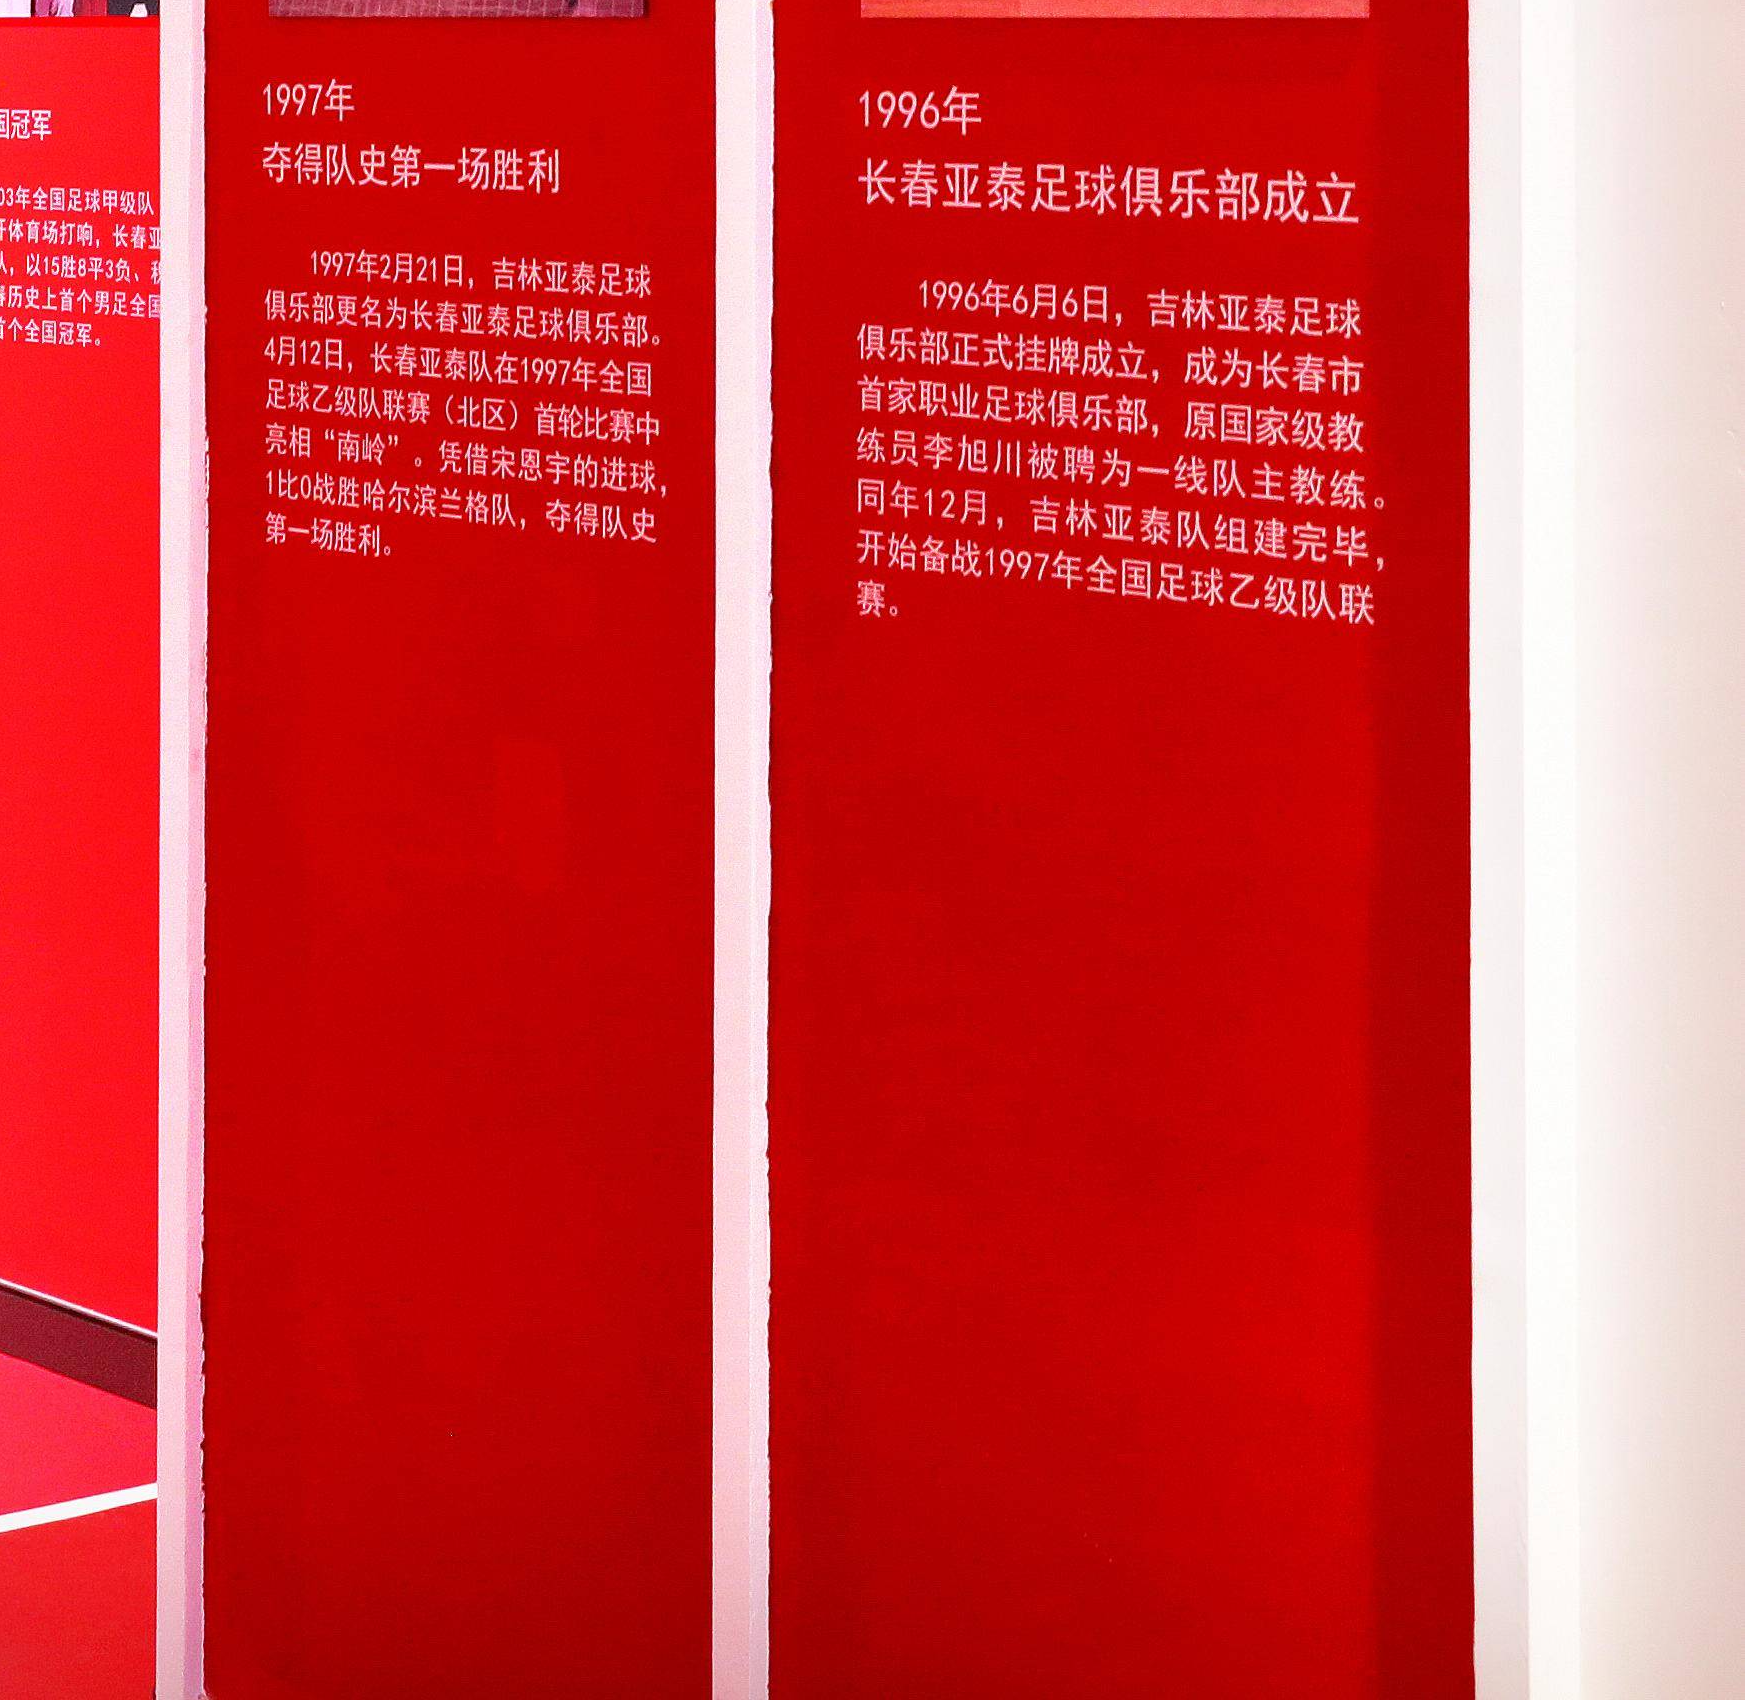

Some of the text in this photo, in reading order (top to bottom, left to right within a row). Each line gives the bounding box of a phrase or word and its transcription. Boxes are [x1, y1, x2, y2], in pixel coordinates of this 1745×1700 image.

[262, 79, 355, 122] 1997年
[858, 86, 983, 136] 1996年
[262, 142, 561, 195] 夺得队史第一场胜利
[858, 158, 1359, 224] 长春亚泰足球俱乐部成立
[310, 249, 652, 299] 1997年2月21日，吉林亚泰足球
[264, 289, 661, 348] 俱乐部更名为长春亚泰足球俱乐部。
[918, 278, 1363, 340] 1996年6月6日，吉林亚泰足球
[264, 336, 653, 398] 4月12日，长春亚泰队在1997年全国
[857, 324, 1365, 397] 俱乐部正式挂牌成立，成为长春市
[857, 376, 1365, 454] 首家职业足球俱乐部，原国家级教
[856, 427, 1386, 511] 练员李旭川被聘为一线队主教练。
[265, 468, 657, 544] 1比0战胜哈尔滨兰格队，夺得队史
[265, 511, 392, 558] 第一场胜利。
[857, 476, 1386, 571] 同年12月，吉林亚泰队组建完毕，
[856, 529, 1376, 626] 开始备战1997年全国足球乙级队联
[857, 580, 900, 618] 赛。
